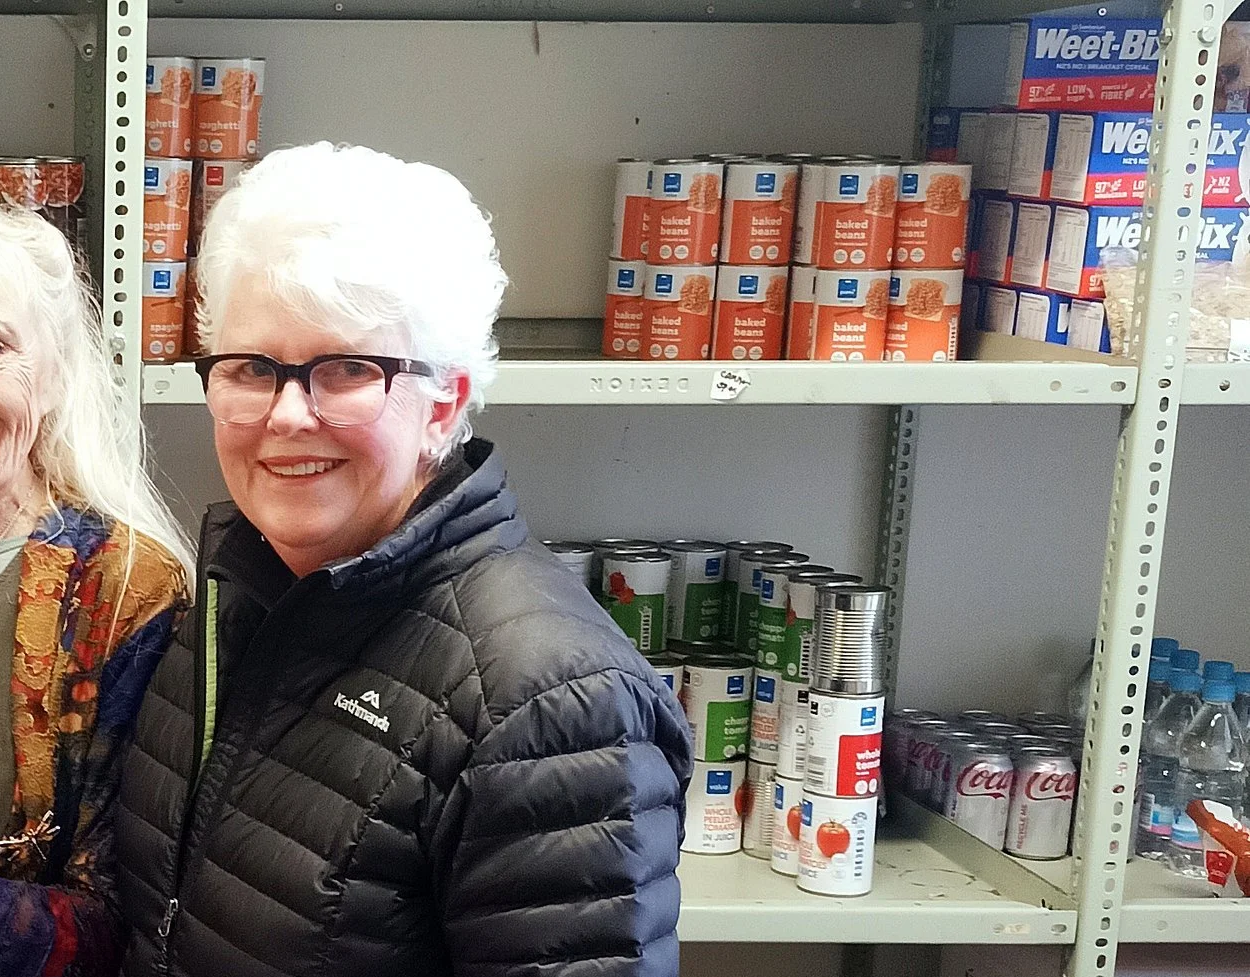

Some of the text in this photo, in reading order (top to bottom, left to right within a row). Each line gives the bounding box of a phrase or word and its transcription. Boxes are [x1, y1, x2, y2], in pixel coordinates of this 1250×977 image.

[661, 216, 691, 225] baked
[751, 216, 783, 225] baked
[836, 219, 868, 229] baked
[660, 227, 689, 236] beans
[751, 227, 780, 236] beans
[835, 230, 866, 240] beans
[614, 310, 643, 320] baked
[614, 320, 641, 330] beans
[652, 316, 682, 326] baked
[735, 317, 766, 327] baked
[651, 327, 679, 336] beans
[834, 322, 867, 332] baked
[734, 328, 764, 337] beans
[833, 333, 864, 342] beans
[334, 692, 390, 732] Kathmandu
[705, 808, 734, 816] WHOLE
[715, 833, 735, 841] JUICE
